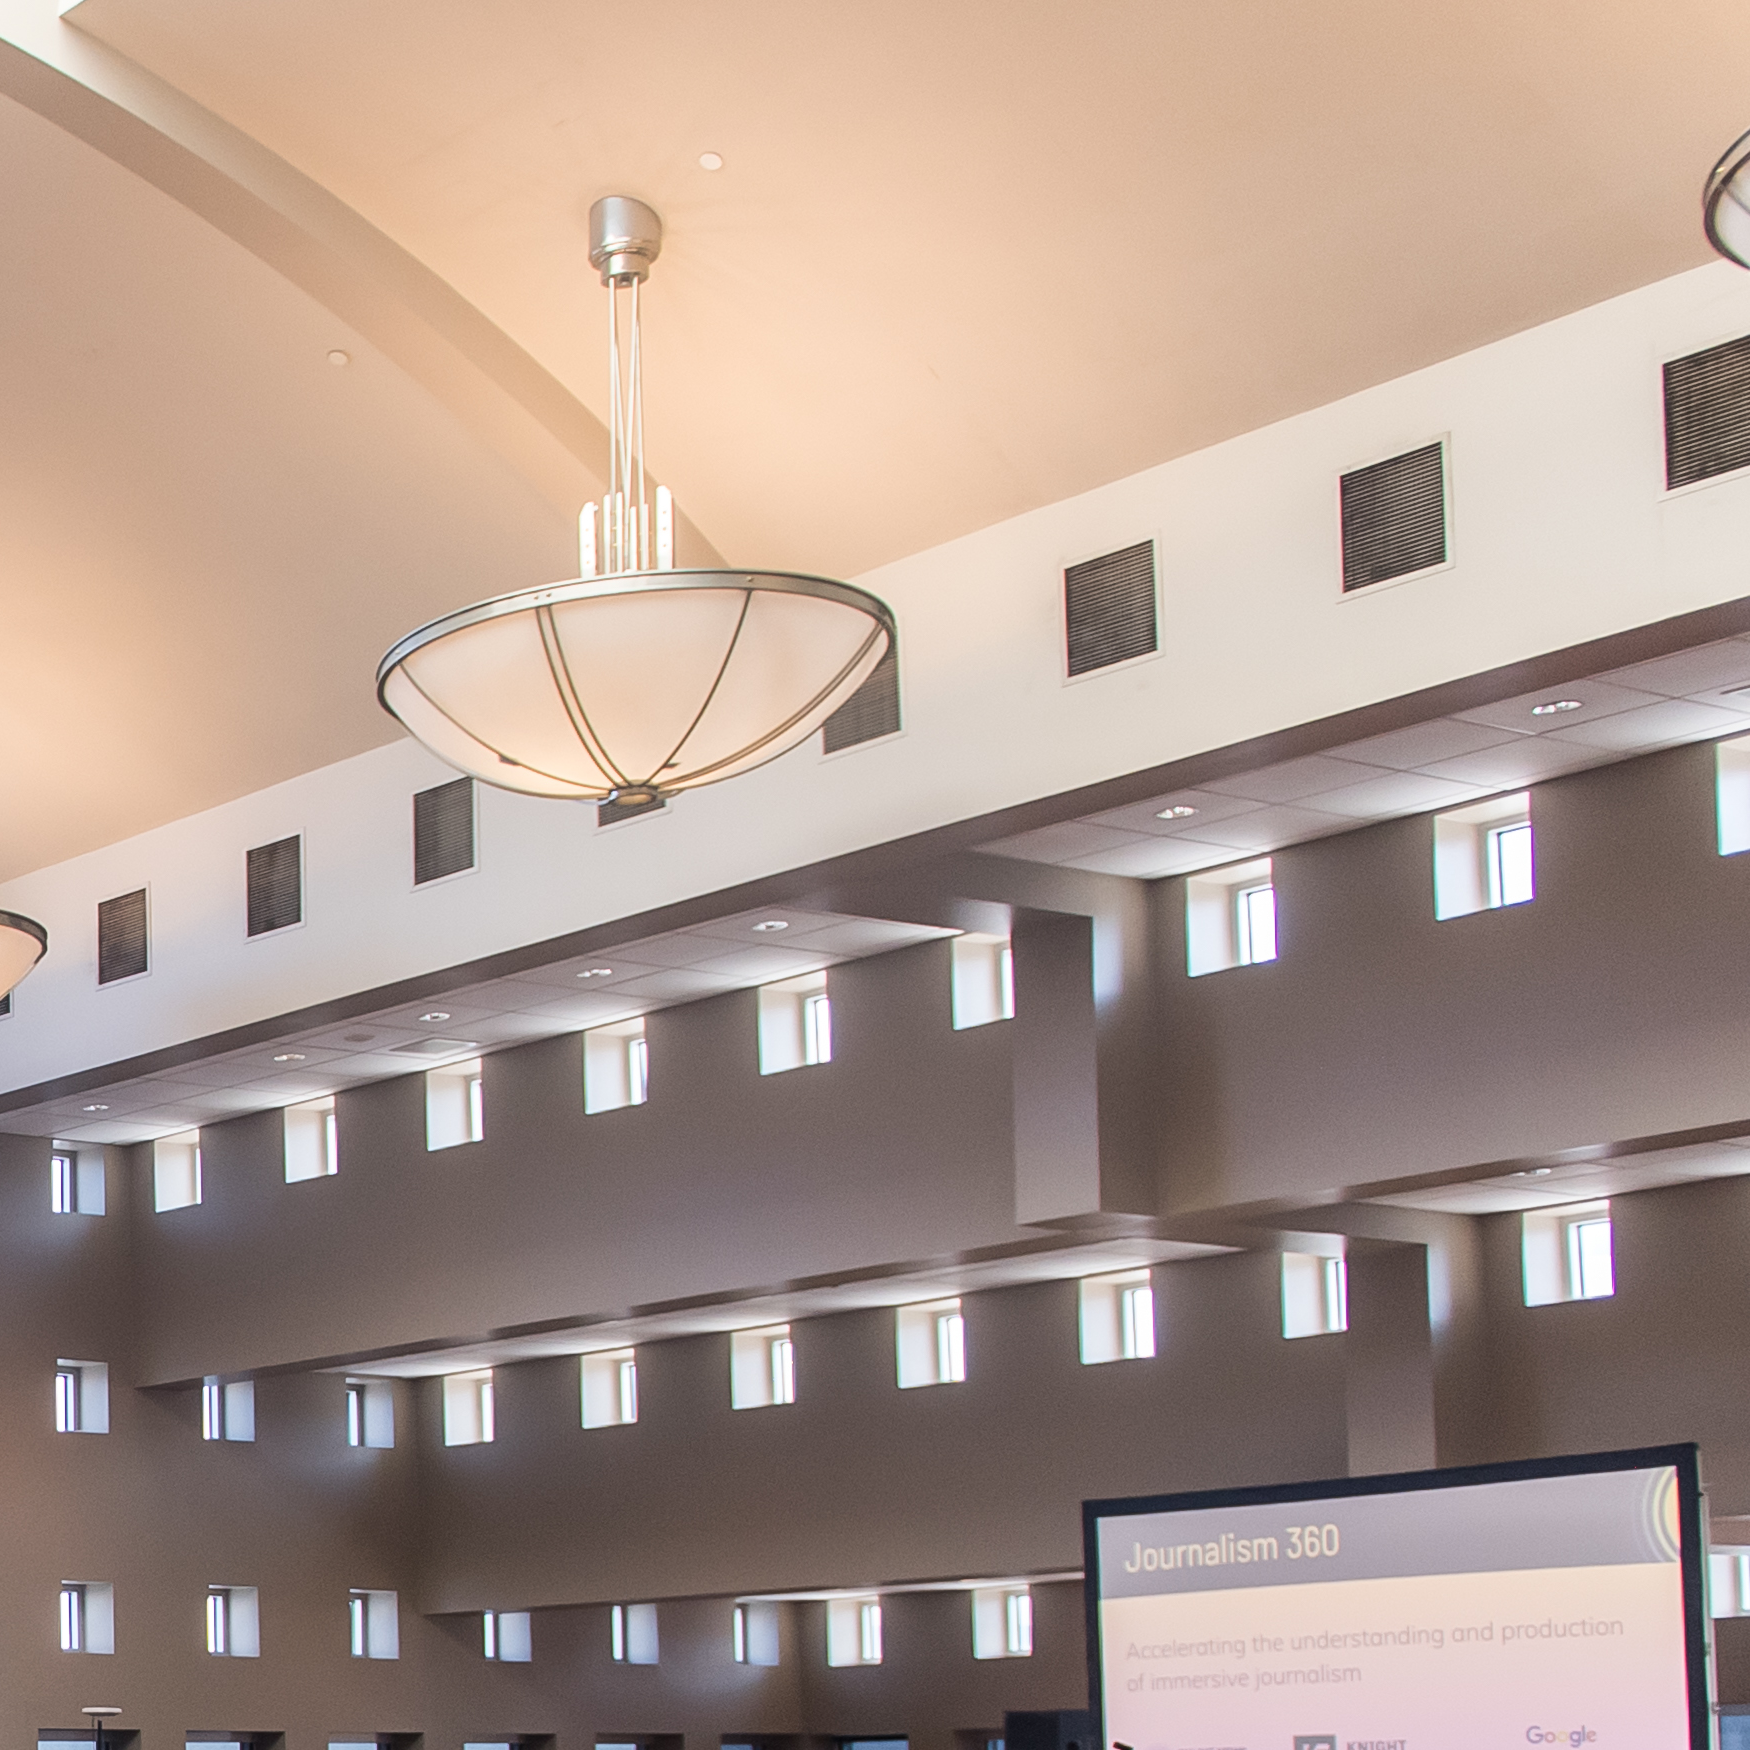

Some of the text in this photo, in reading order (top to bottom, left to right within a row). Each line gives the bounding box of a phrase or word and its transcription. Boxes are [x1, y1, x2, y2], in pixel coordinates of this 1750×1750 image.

[1125, 1523, 1341, 1573] Journalism 360
[1126, 1617, 1624, 1661] Accelerating the understanding and production
[1127, 1663, 1362, 1693] of immersive journalism
[1525, 1724, 1597, 1748] Google
